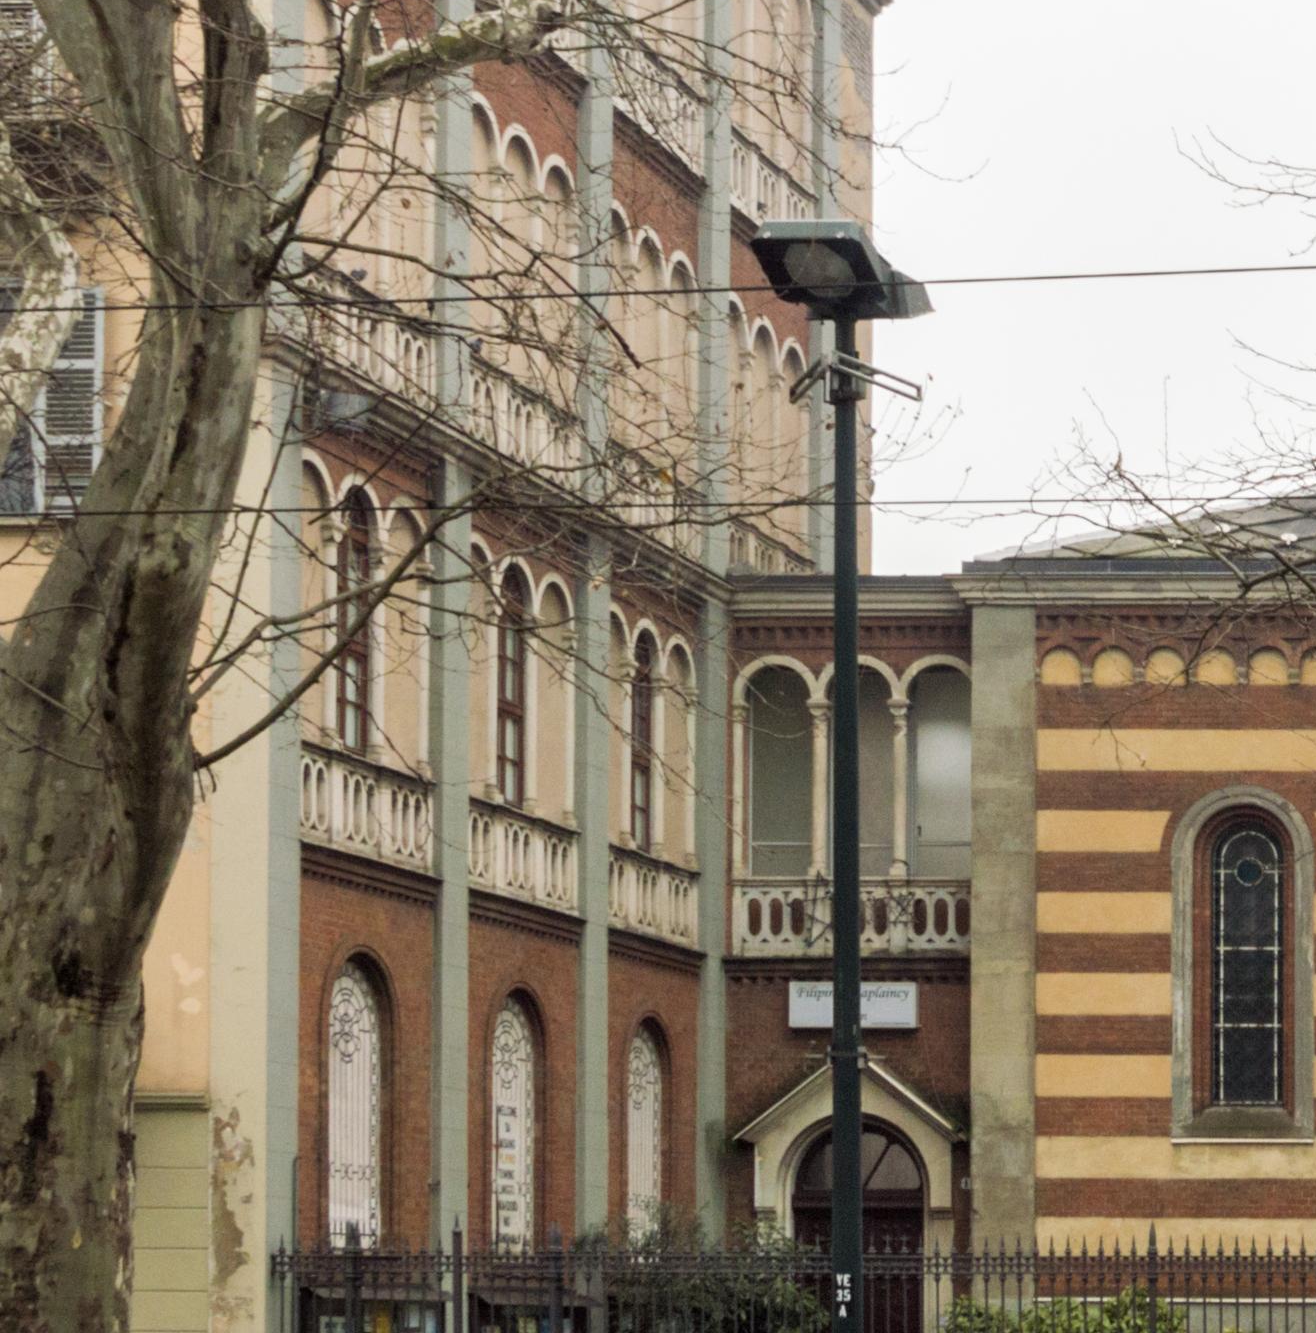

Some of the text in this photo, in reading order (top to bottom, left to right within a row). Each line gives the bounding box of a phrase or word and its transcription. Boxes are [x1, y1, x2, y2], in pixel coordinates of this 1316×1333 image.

[836, 1273, 852, 1287] VE
[835, 1288, 852, 1302] 35
[838, 1304, 848, 1318] A
